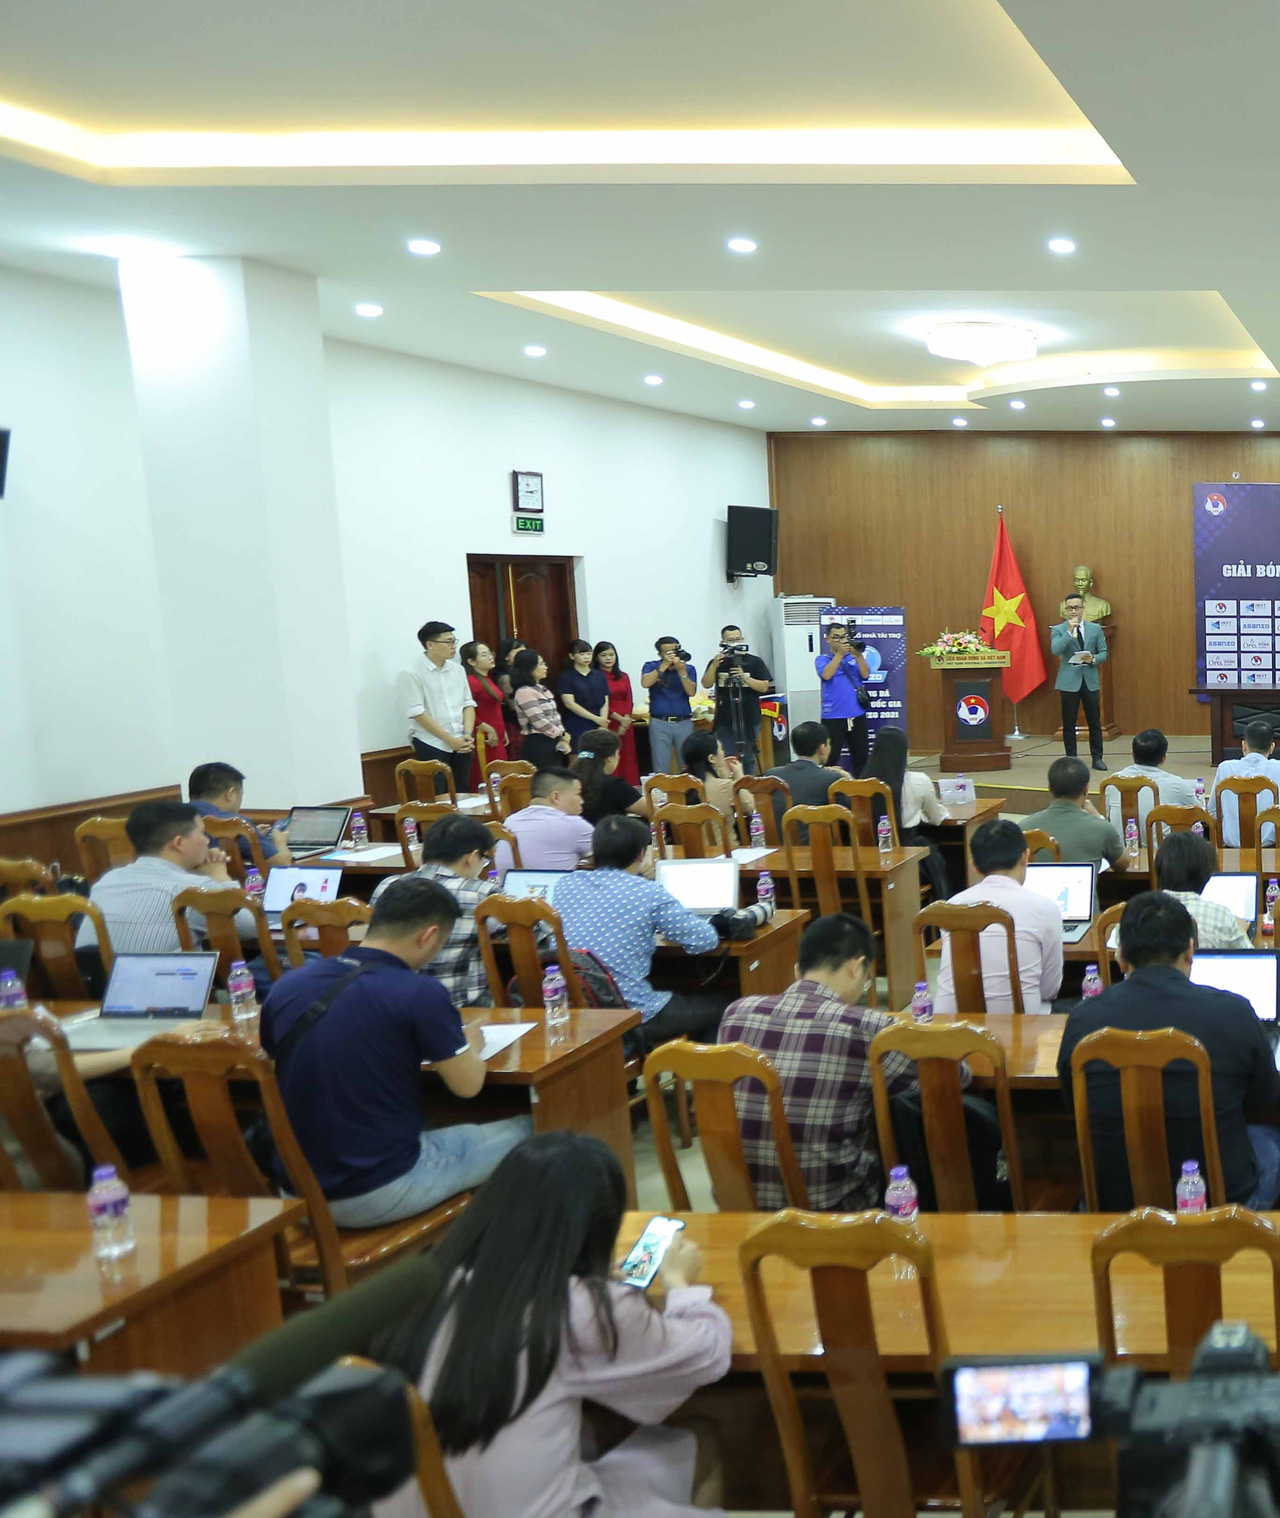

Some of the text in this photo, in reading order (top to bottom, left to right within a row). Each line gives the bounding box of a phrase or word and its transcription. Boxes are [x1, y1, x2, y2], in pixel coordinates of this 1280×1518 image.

[518, 520, 541, 529] EXIT
[1222, 560, 1252, 577] GIẢI
[870, 699, 887, 708] UỐC
